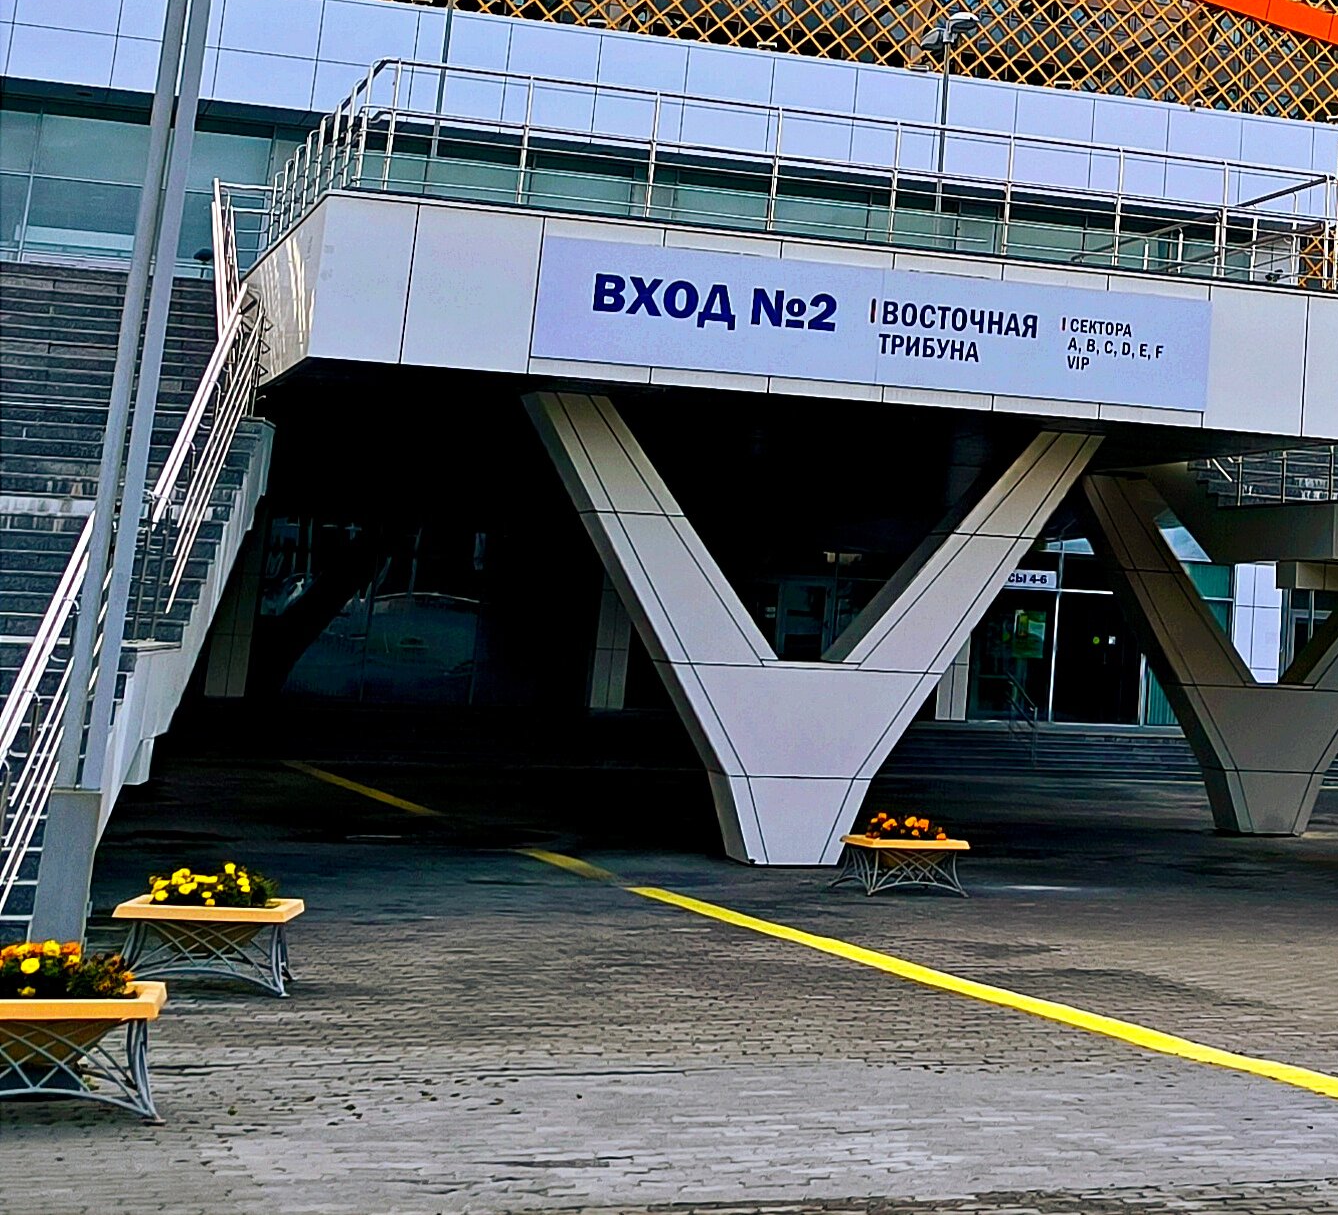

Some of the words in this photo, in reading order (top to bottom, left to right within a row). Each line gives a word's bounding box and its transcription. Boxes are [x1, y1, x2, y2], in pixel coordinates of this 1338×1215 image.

[592, 273, 736, 330] ВХОД
[750, 287, 837, 332] №2
[882, 301, 1038, 338] ВОСТОЧНАЯ
[1070, 318, 1132, 338] СЕКТОРА
[878, 333, 979, 363] ТРИБУНА
[1155, 345, 1164, 359] F
[1067, 355, 1090, 370] VIP
[1029, 574, 1048, 584] 4-6
